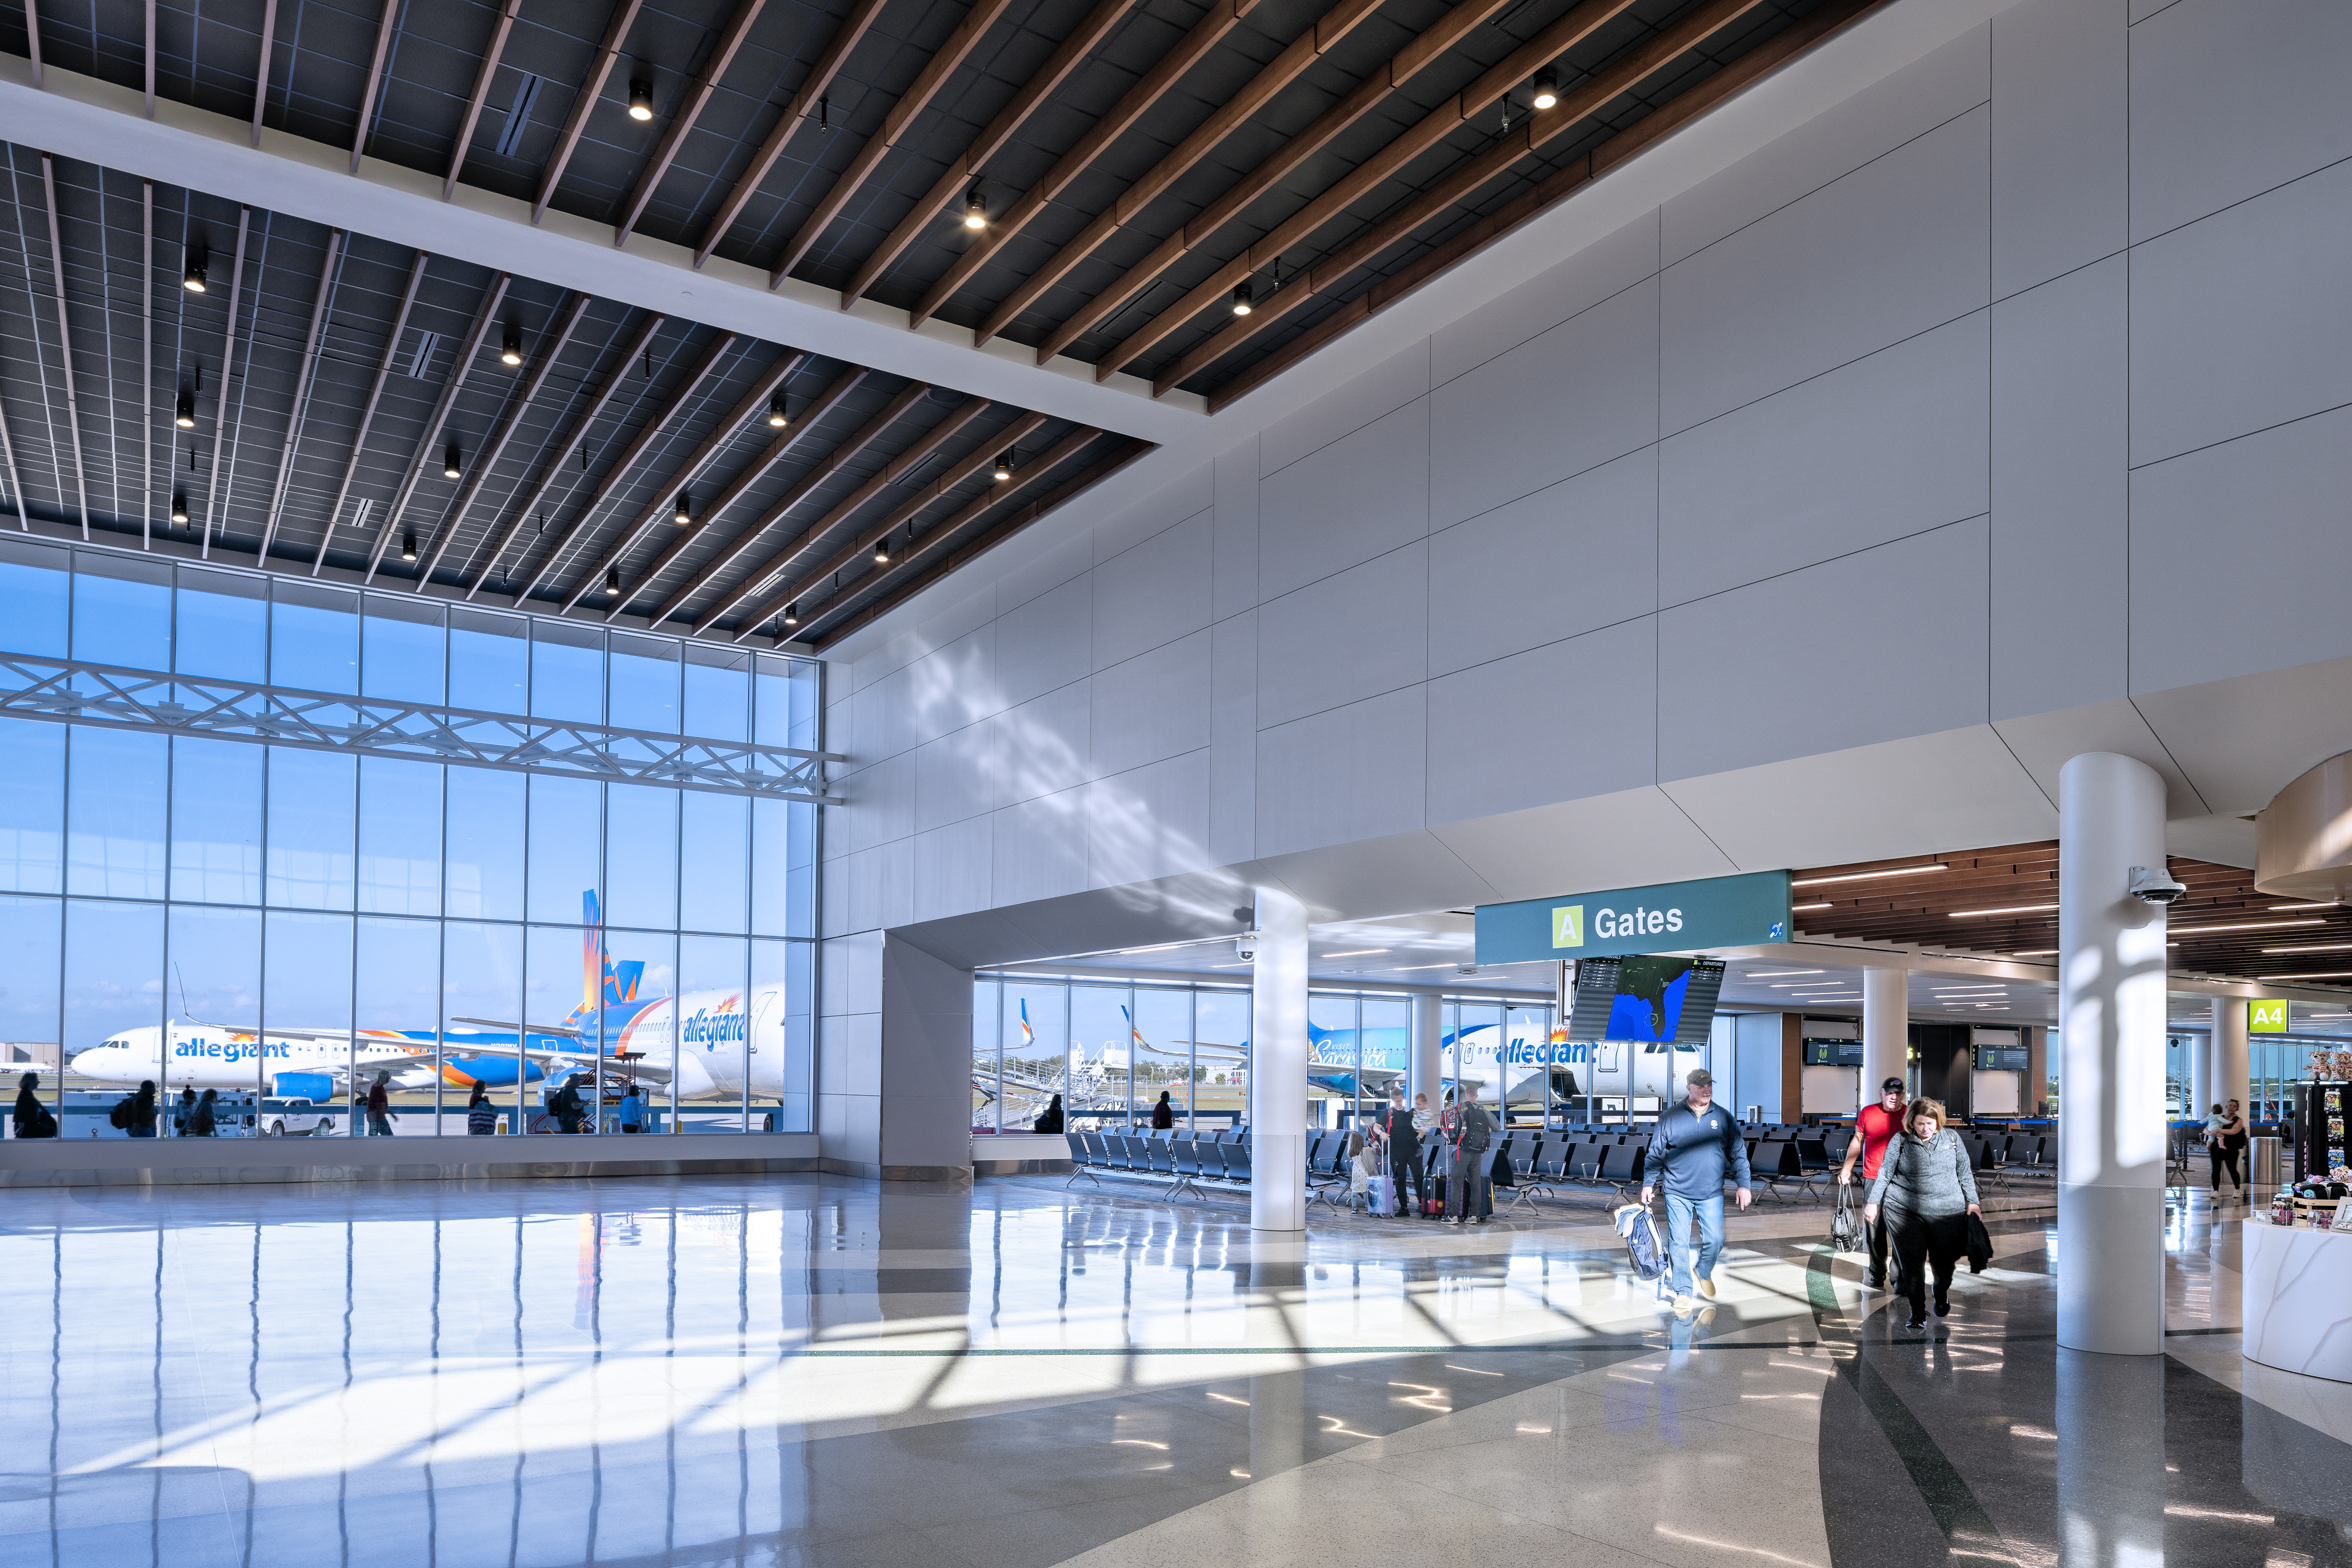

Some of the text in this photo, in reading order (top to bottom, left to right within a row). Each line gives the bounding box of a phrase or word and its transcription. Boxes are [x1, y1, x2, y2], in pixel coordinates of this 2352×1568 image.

[1559, 907, 1683, 941] A Gates
[2253, 1008, 2283, 1025] A4
[175, 1038, 290, 1063] allegiant
